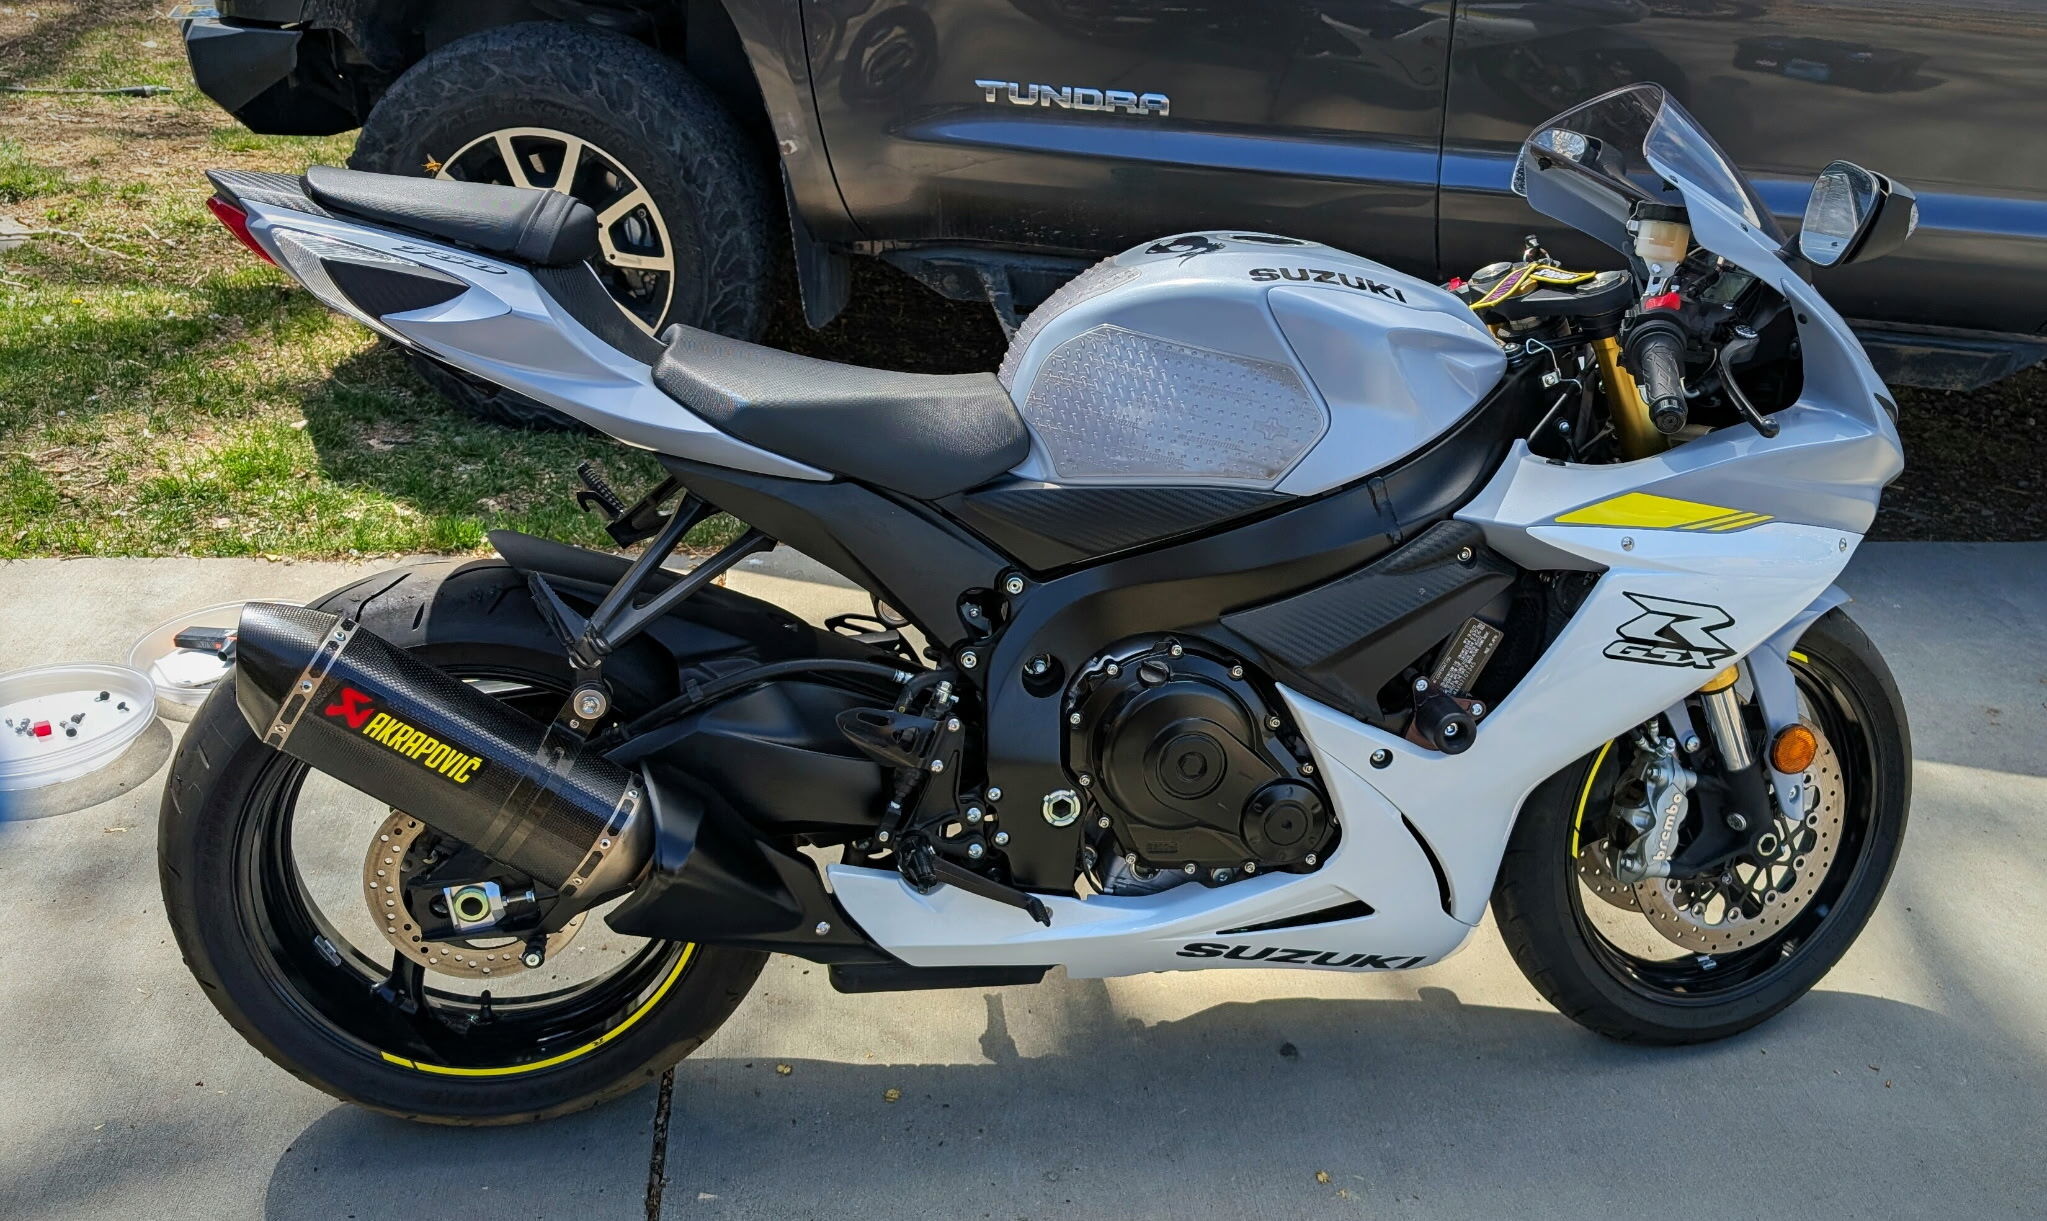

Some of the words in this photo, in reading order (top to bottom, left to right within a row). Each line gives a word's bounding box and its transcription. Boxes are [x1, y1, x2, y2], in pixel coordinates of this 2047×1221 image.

[974, 79, 1170, 117] TUNDRA
[1249, 267, 1408, 304] SUZUKI
[1602, 639, 1730, 669] GSX
[1652, 793, 1683, 861] brembo
[1175, 942, 1427, 970] SUZUKI
